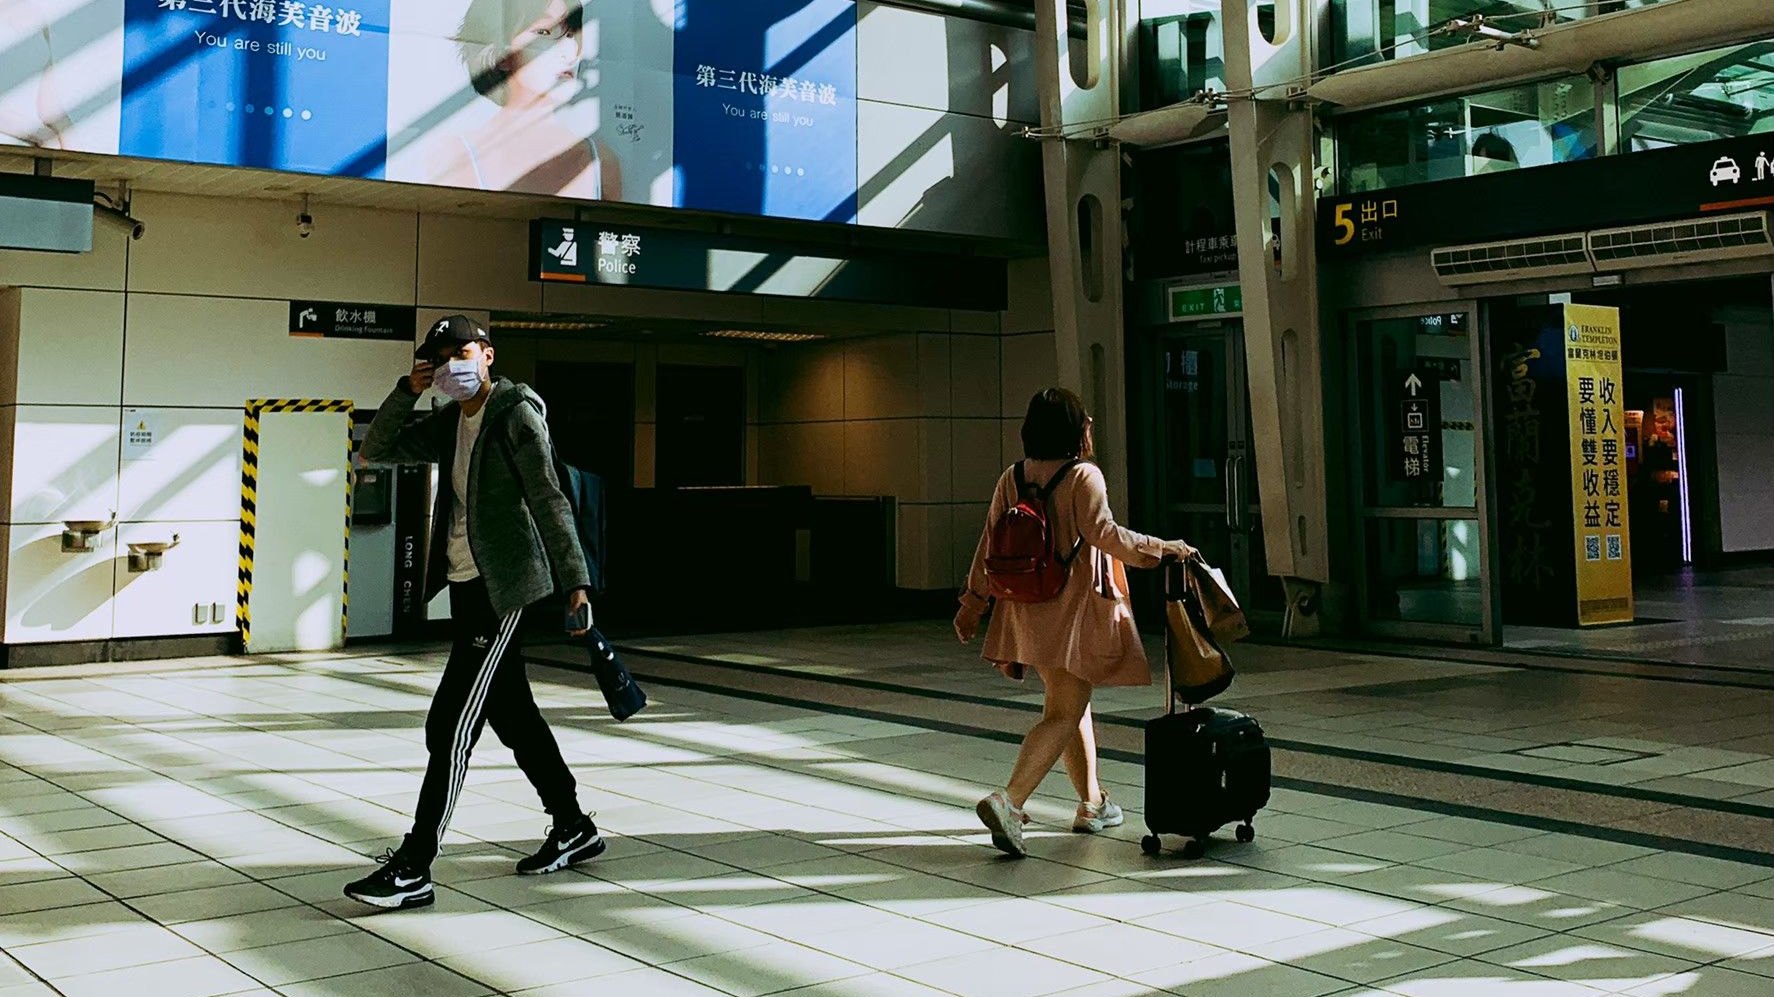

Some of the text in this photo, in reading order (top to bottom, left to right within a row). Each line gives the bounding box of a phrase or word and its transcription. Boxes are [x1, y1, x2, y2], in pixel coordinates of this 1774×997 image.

[194, 30, 327, 61] You are still you
[696, 63, 838, 106] 第三代海芙音波
[722, 103, 814, 127] You are still you
[1334, 203, 1355, 245] 5
[1361, 199, 1397, 224] 出口
[597, 231, 641, 256] 警察
[1361, 227, 1383, 241] Exit
[598, 258, 636, 274] Police
[335, 307, 377, 324] 飲水機
[1581, 325, 1612, 335] FRANKLIN
[1582, 334, 1618, 345] TEMPLETON
[1402, 435, 1420, 477] 電梯
[1578, 376, 1601, 528] 要懂雙收益
[1599, 376, 1621, 528] 收入要穩定
[404, 535, 414, 568] LONG
